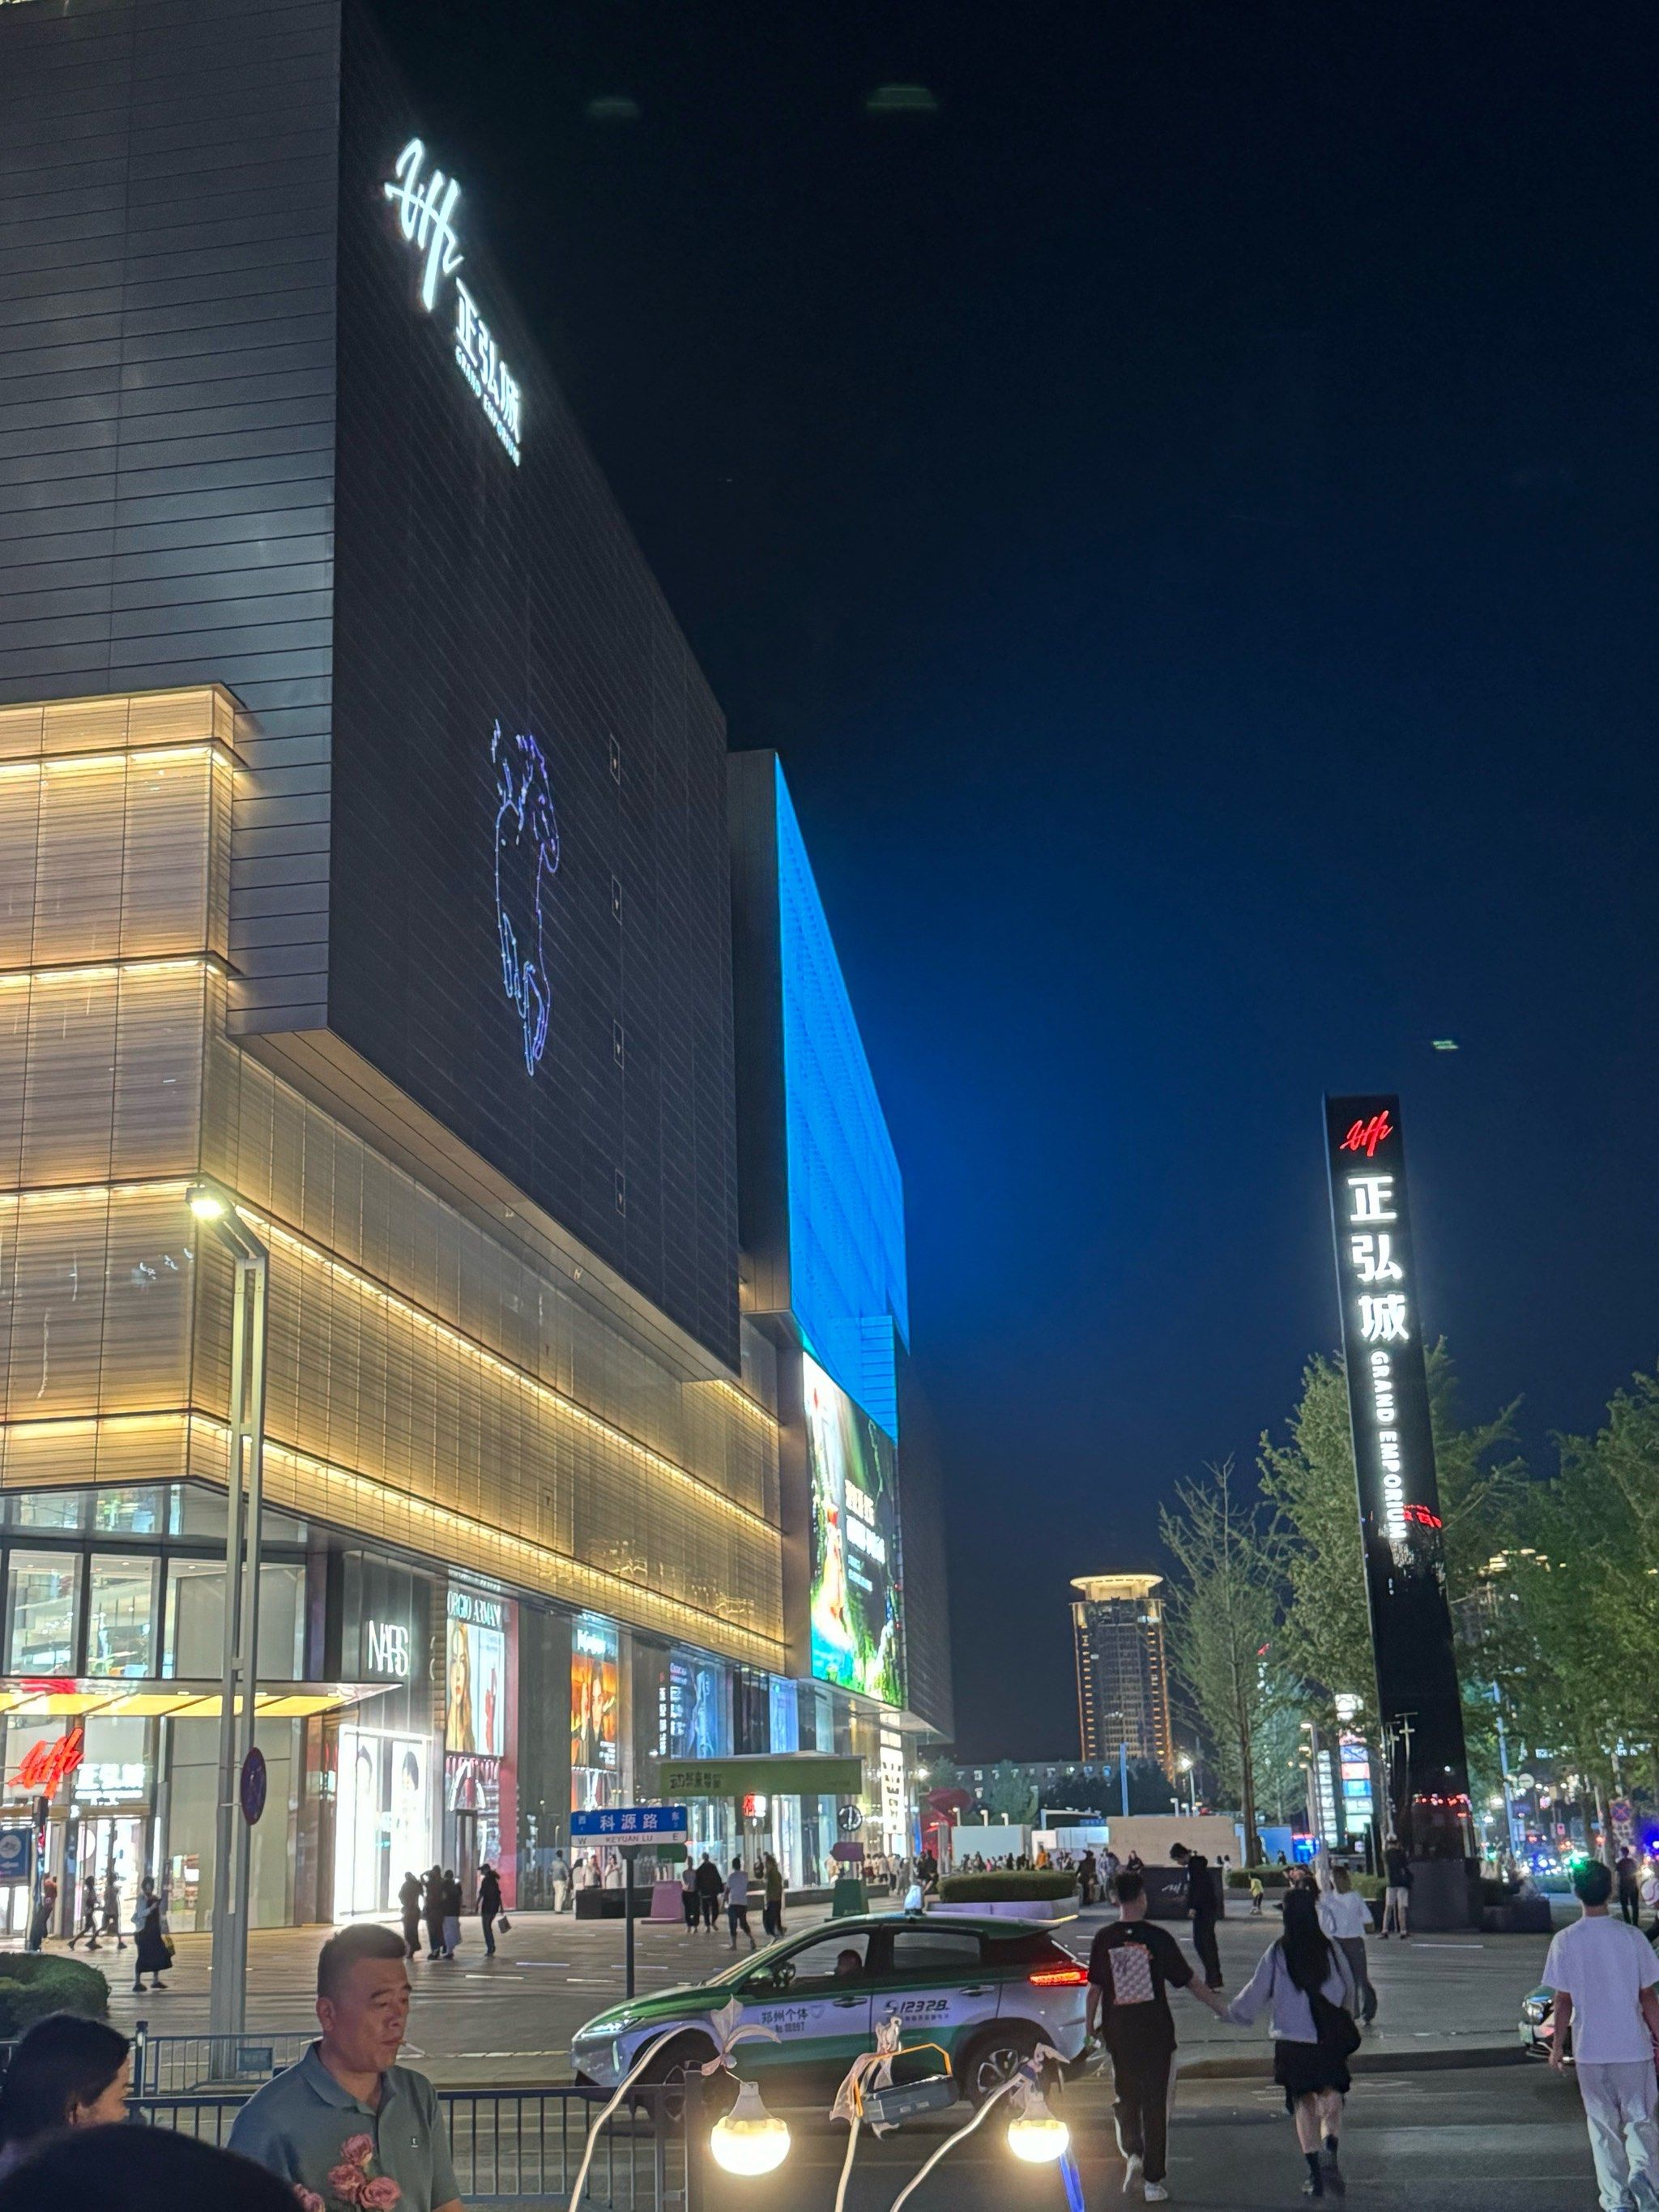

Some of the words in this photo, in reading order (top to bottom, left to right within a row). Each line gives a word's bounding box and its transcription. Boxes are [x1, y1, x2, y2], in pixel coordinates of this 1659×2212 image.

[455, 345, 482, 398] GRAND
[484, 394, 521, 468] EMPORIUM
[1347, 1176, 1410, 1342] 正弘城
[1371, 1351, 1395, 1423] GRAND
[1379, 1430, 1407, 1539] EMPORIUM
[369, 1620, 408, 1676] NARS
[578, 1837, 586, 1845] W
[606, 1835, 639, 1843] KEYUAN
[642, 1834, 654, 1843] LU
[672, 1833, 679, 1841] E
[599, 1813, 659, 1831] 科源路
[761, 2008, 808, 2024] 郑州个体
[899, 1999, 948, 2013] 12328
